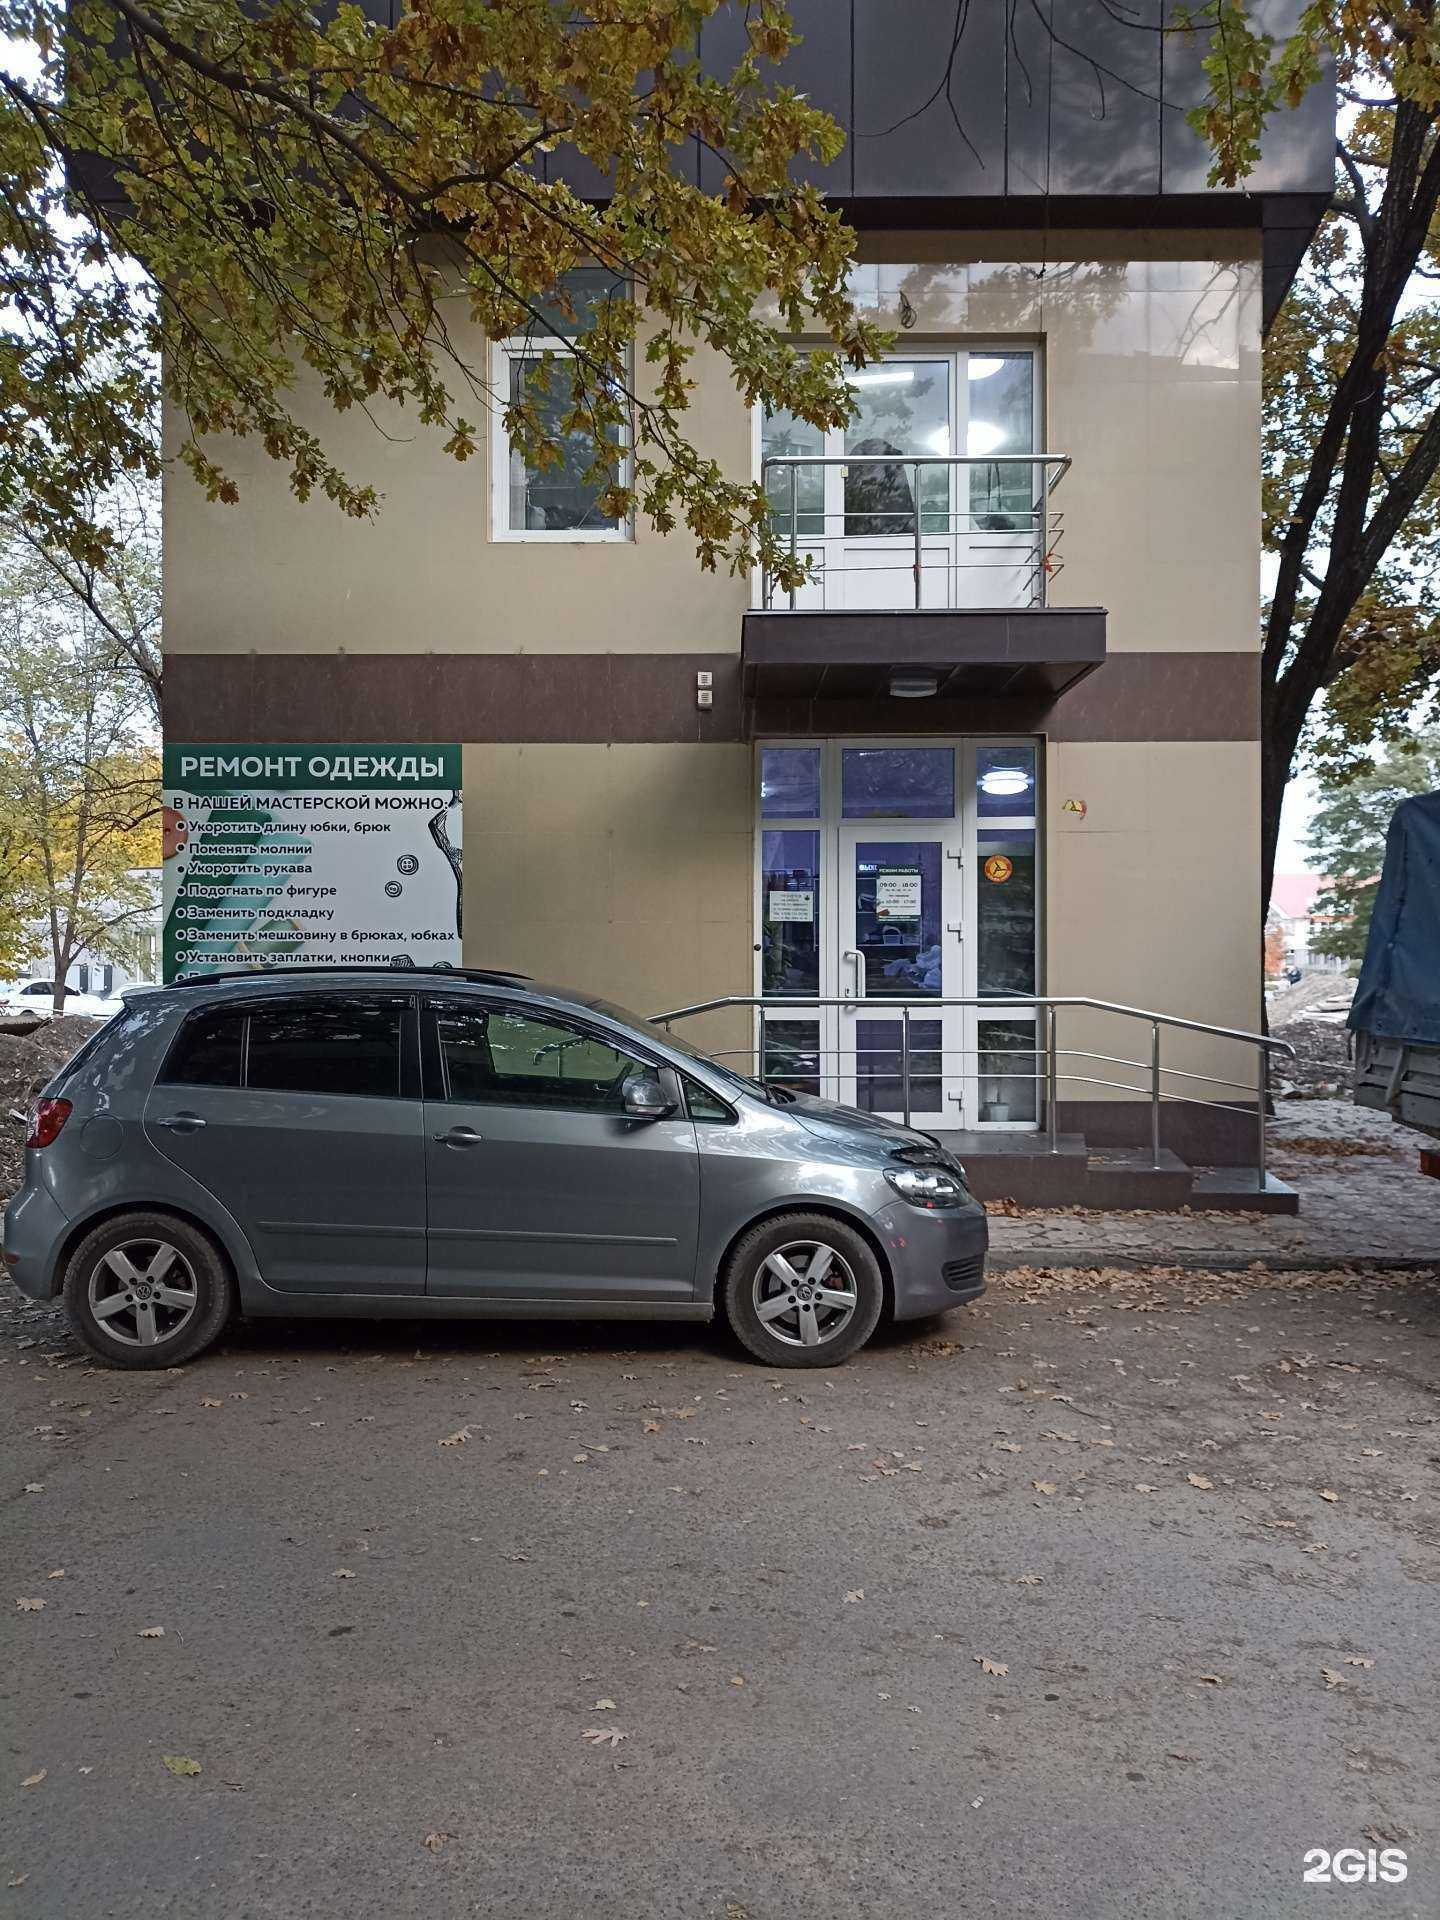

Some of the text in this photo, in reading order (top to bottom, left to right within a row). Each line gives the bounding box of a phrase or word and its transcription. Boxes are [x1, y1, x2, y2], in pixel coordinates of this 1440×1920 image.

[180, 756, 445, 781] РЕМОНТ ОДЕЖДЫ
[173, 794, 448, 810] В НАШЕЙ МАСТЕРСКОЙ МОЖНО:
[189, 821, 391, 836] Укоротить длину юбки, брюк
[189, 843, 313, 855] Поменять молнии
[189, 863, 313, 876] Укоротить рукава
[189, 884, 338, 898] Подогнать по фигуре
[188, 906, 335, 921] Заменить подкладку
[188, 929, 455, 943] Заменить мешковину в брюках, юбках
[188, 951, 390, 964] Установить заплатки, кнопки
